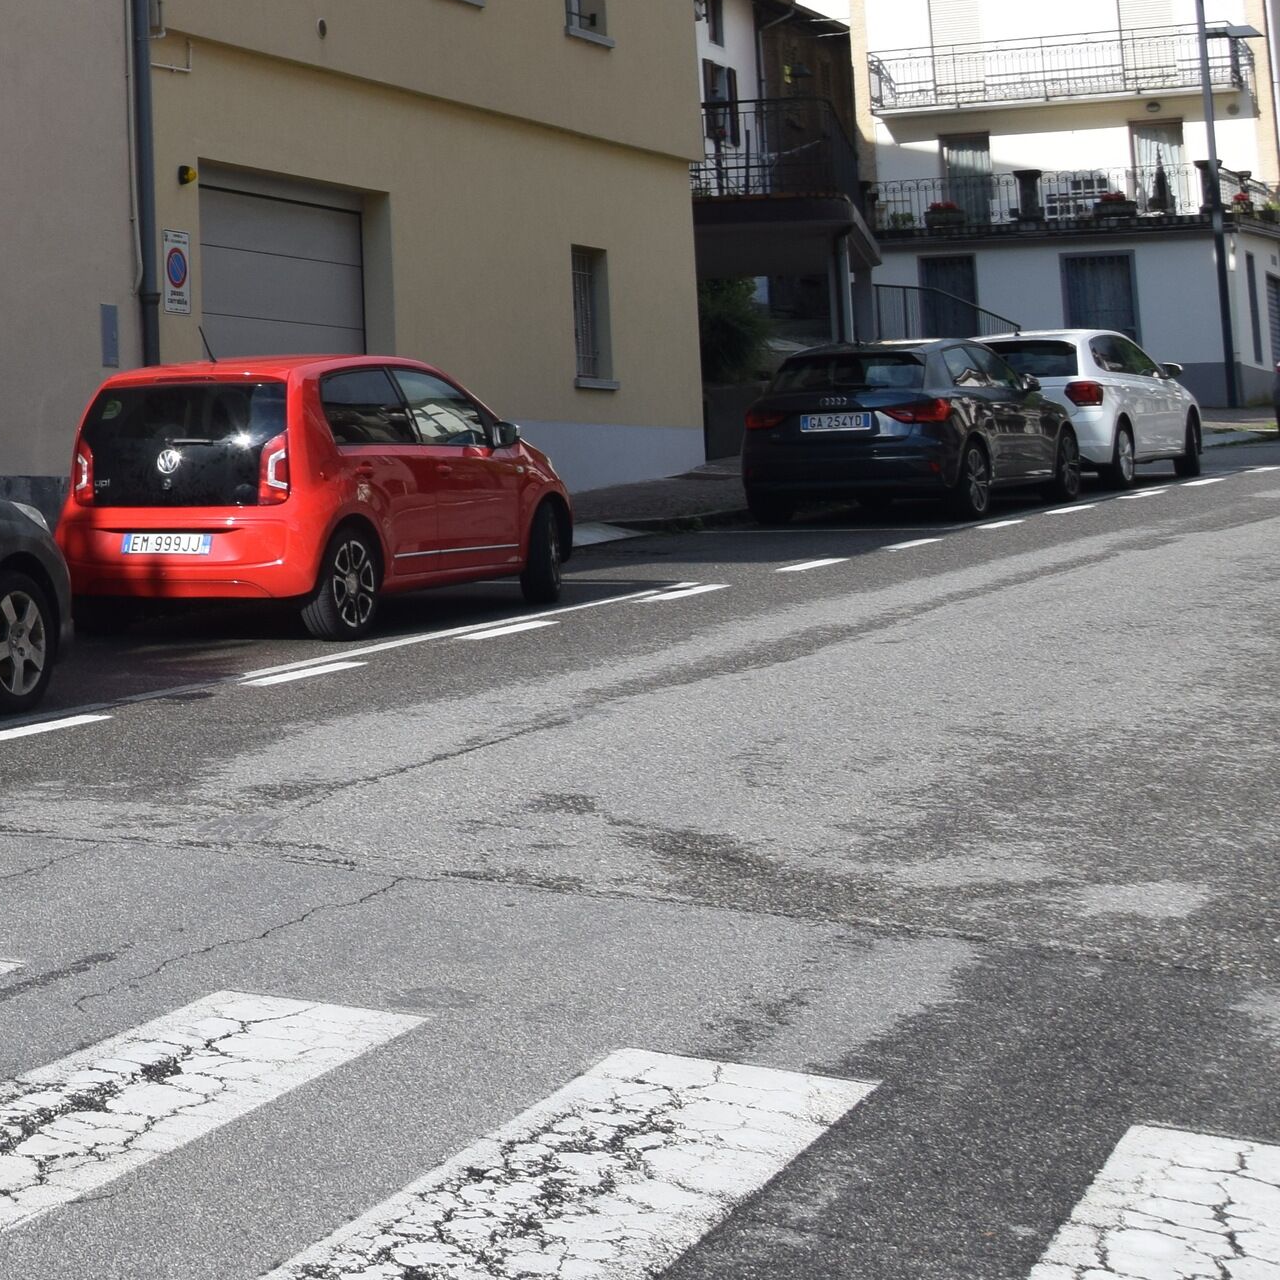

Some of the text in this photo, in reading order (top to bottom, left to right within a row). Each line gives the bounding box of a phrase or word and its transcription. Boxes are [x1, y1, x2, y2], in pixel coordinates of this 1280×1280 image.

[809, 414, 862, 429] GA 254YD
[131, 536, 149, 552] EM
[154, 535, 201, 552] 999JJ
